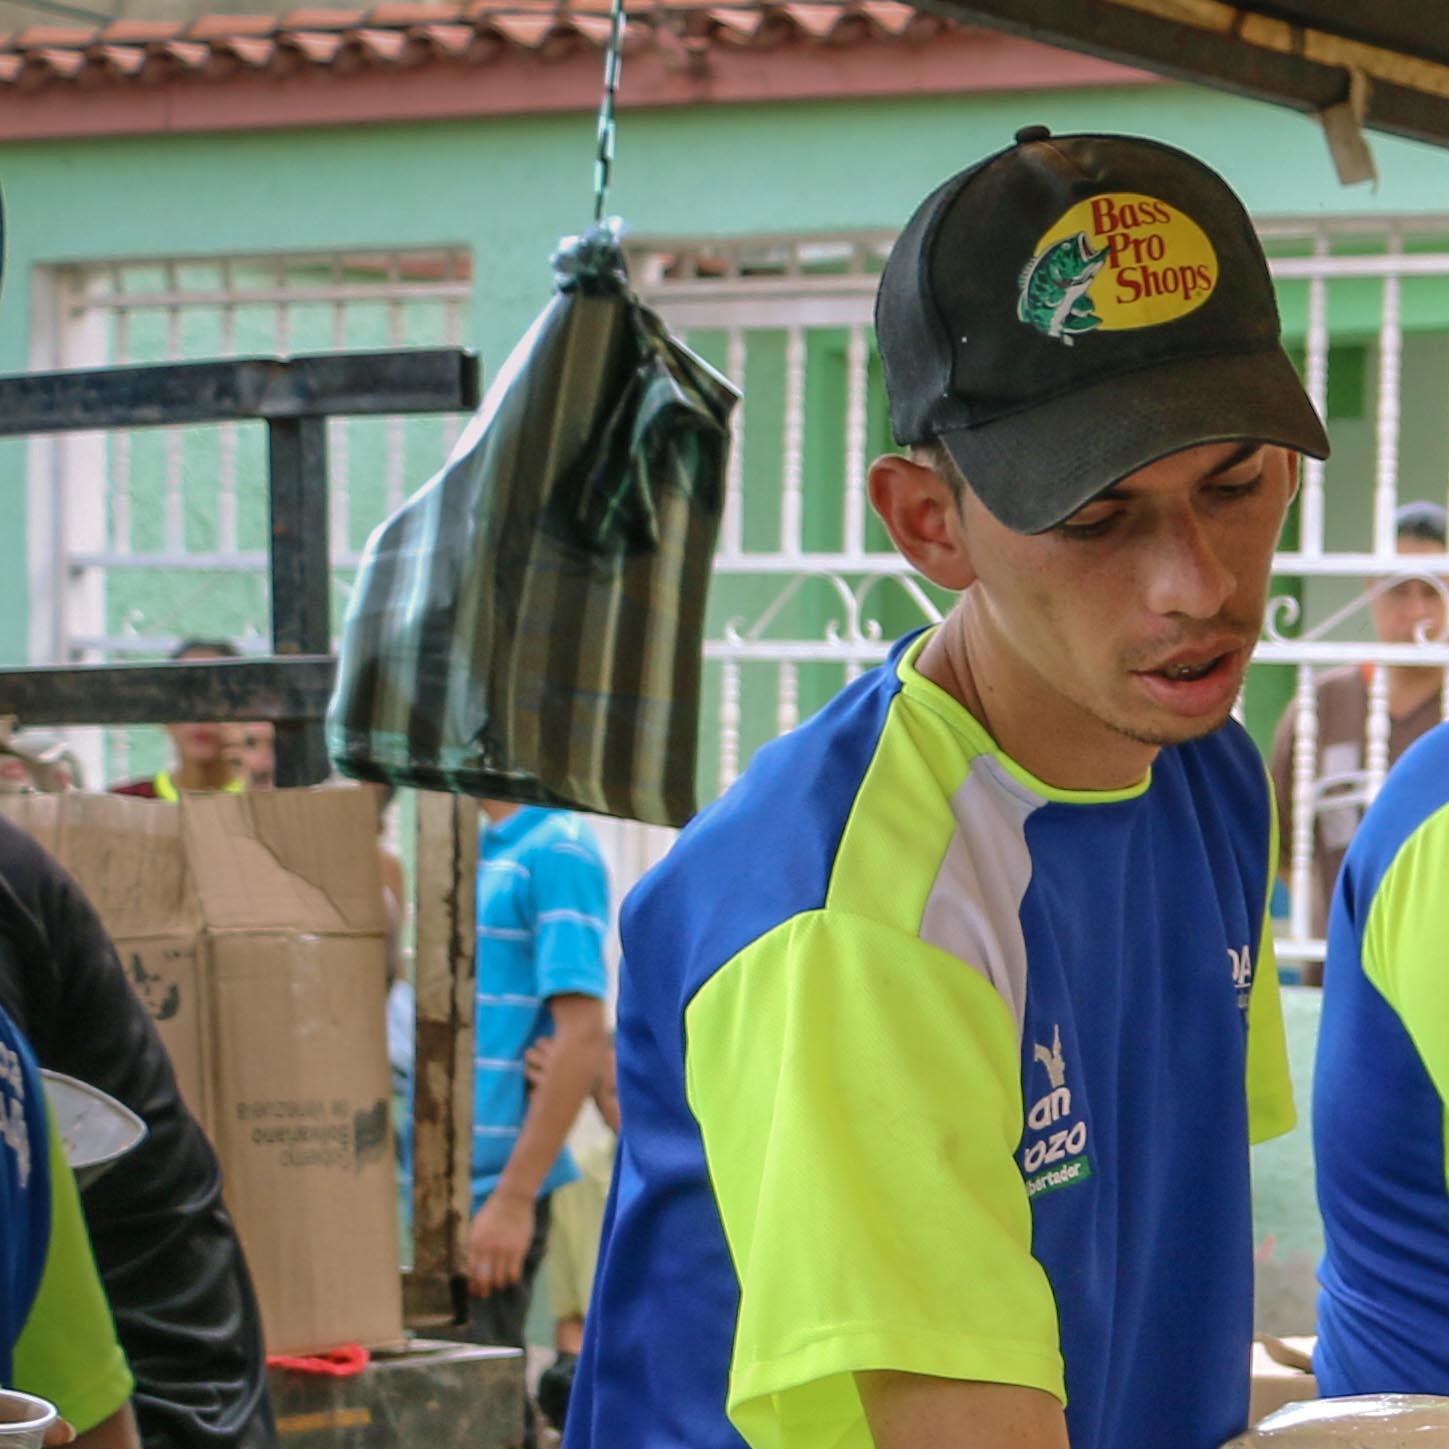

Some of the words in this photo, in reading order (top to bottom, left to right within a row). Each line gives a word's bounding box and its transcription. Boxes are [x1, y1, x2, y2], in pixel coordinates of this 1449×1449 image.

[1091, 198, 1171, 235] Bass
[1107, 232, 1165, 269] Pro
[1115, 264, 1212, 304] Shops
[1023, 1120, 1087, 1173] ozo
